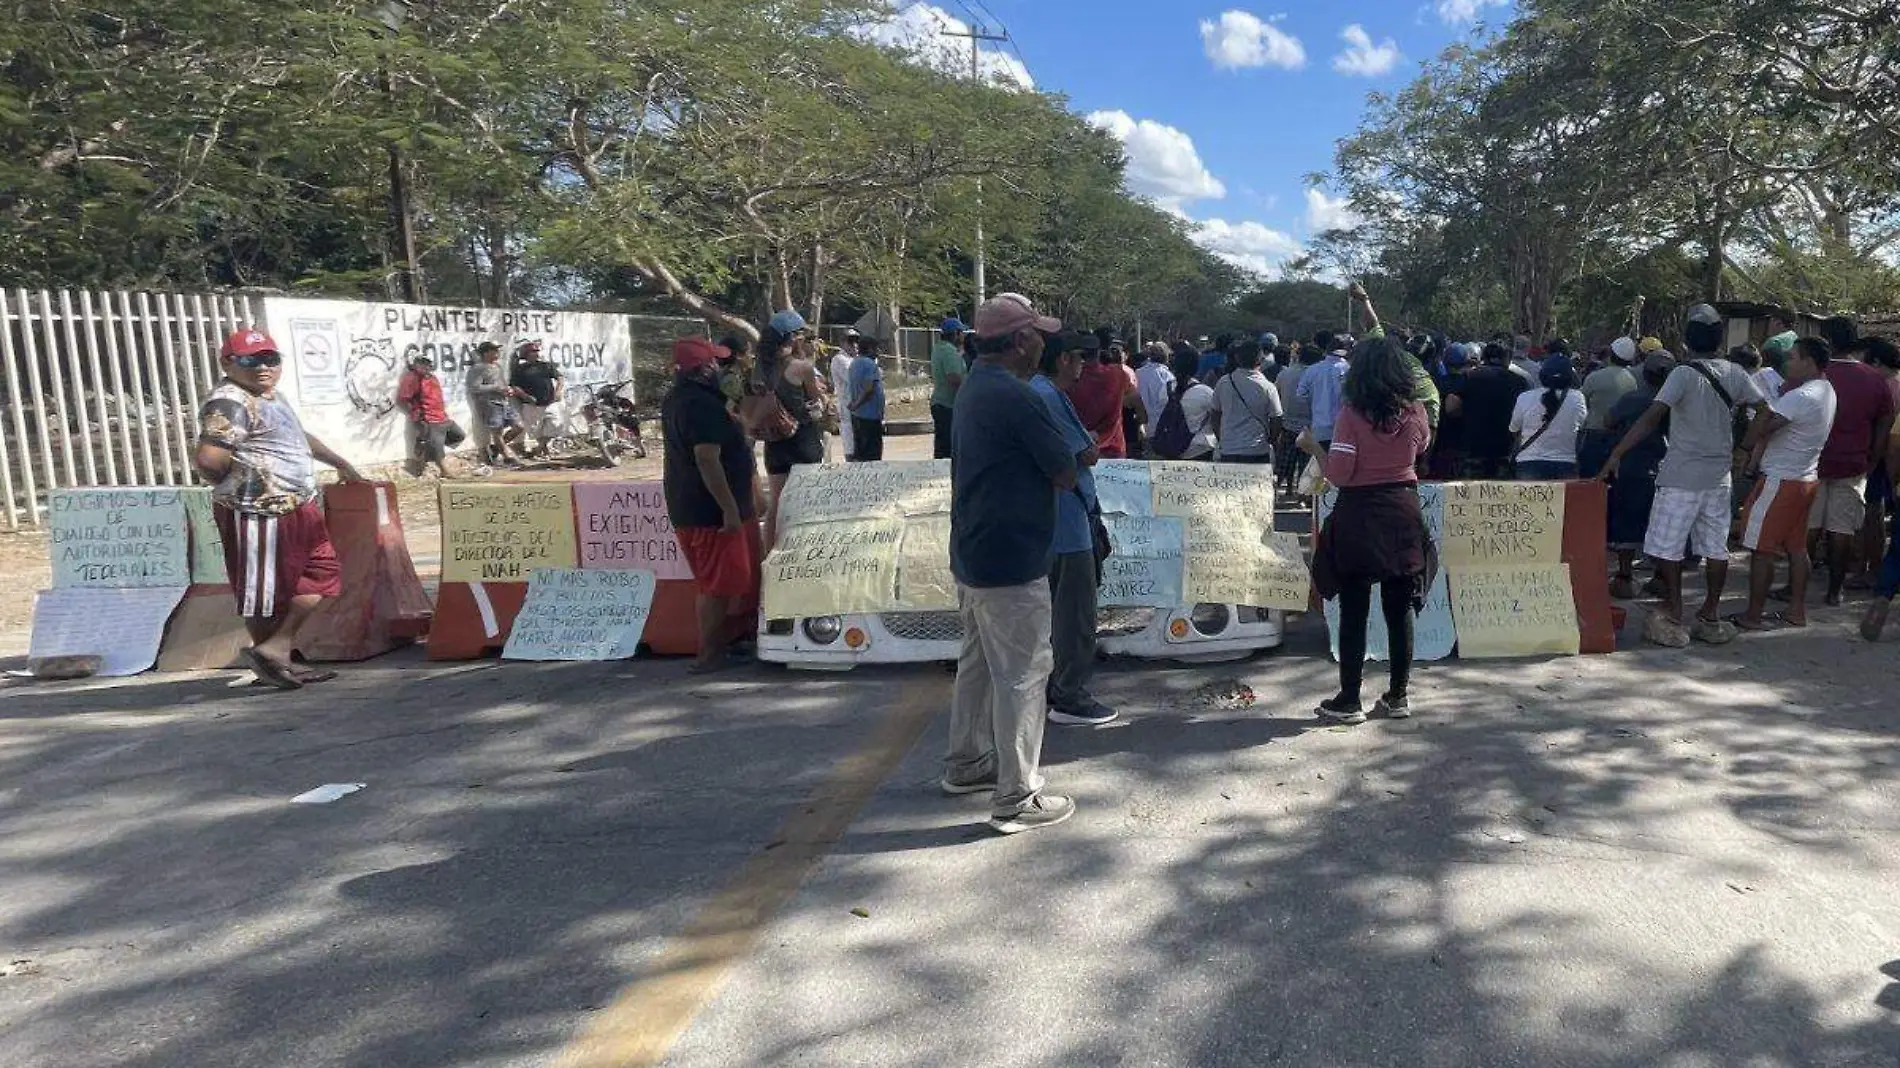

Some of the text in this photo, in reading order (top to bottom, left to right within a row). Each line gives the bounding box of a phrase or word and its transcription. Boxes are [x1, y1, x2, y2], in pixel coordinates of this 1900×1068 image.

[385, 308, 556, 333] PLANTEL PISTE
[404, 343, 477, 373] COBA
[551, 342, 606, 368] COBAY
[53, 491, 138, 511] EXIGIMOS
[609, 491, 662, 509] AMLO
[1454, 483, 1554, 501] NO MAS ROBO
[106, 509, 127, 525] DE
[485, 512, 531, 524] DE LAS
[1450, 502, 1556, 520] DE TIERRAS A
[52, 523, 175, 543] DIALOGO CON LAS
[589, 513, 675, 534] EXIGIMO
[1448, 520, 1543, 537] LOS PUEBLOS
[63, 541, 171, 561] AUTORIDADES
[455, 545, 514, 561] DIRECTOR
[587, 539, 677, 561] JUSTICIA
[1471, 535, 1537, 559] MAYAS
[779, 557, 879, 581] LENGUA MAYA
[597, 571, 641, 588] ROBO
